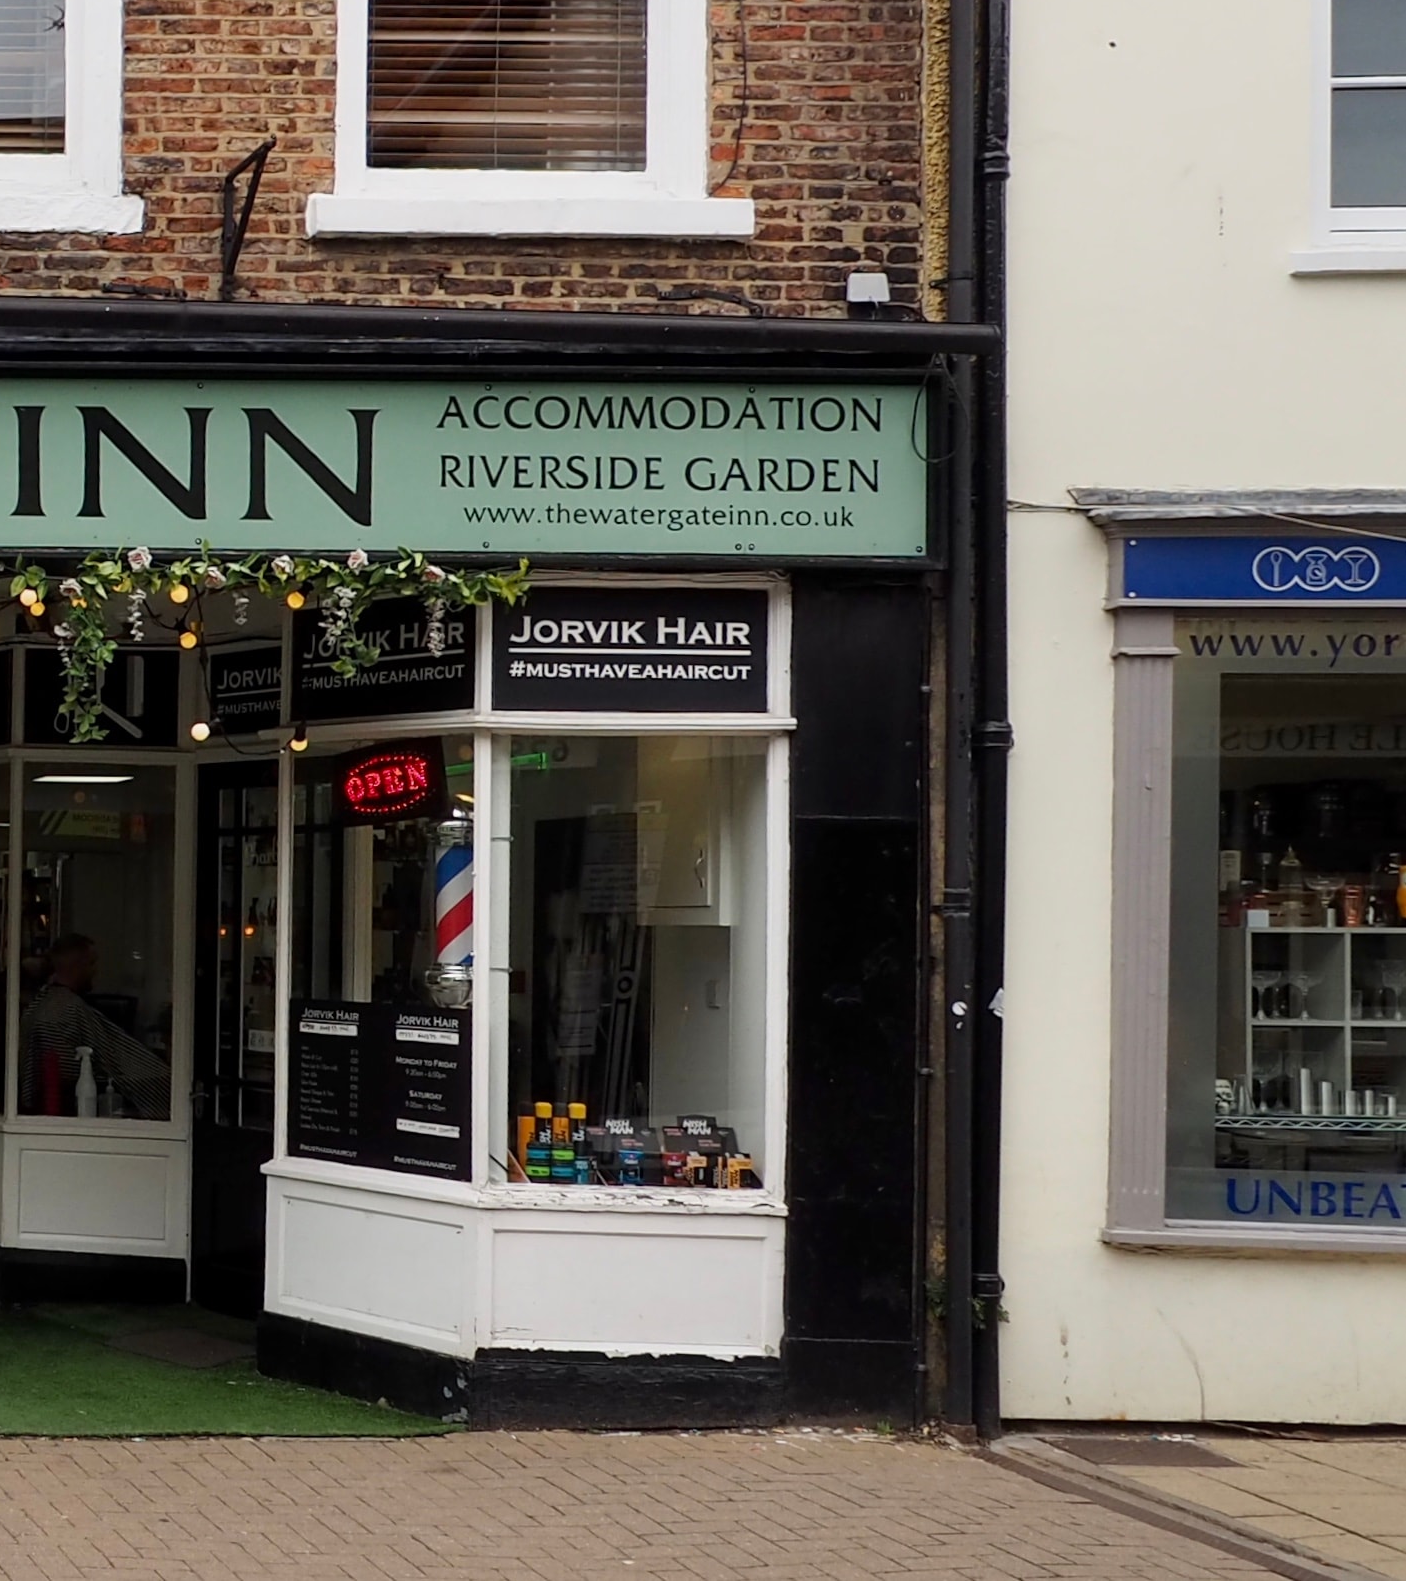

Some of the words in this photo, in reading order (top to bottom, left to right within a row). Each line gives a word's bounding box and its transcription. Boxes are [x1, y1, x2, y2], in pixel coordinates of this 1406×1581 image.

[435, 394, 883, 433] ACCOMMODATION
[9, 404, 381, 527] INN
[439, 454, 665, 491] RIVERSIDE
[684, 457, 880, 493] GARDEN
[463, 503, 855, 533] www.thewatergateinn.co.uk
[399, 621, 465, 650] HAR
[508, 614, 645, 646] JORVIK
[656, 616, 751, 646] HAIR
[302, 664, 466, 691] #MUSTHAVEAHAIRCUT
[508, 659, 752, 681] #MUSTHAVEAHAIRCUT
[344, 760, 428, 803] OPEN
[301, 1007, 335, 1020] JORVIK
[335, 1009, 360, 1022] HAIR
[395, 1014, 432, 1027] JORVIK
[433, 1016, 459, 1029] HAIR
[1226, 1177, 1406, 1219] UNBEA
